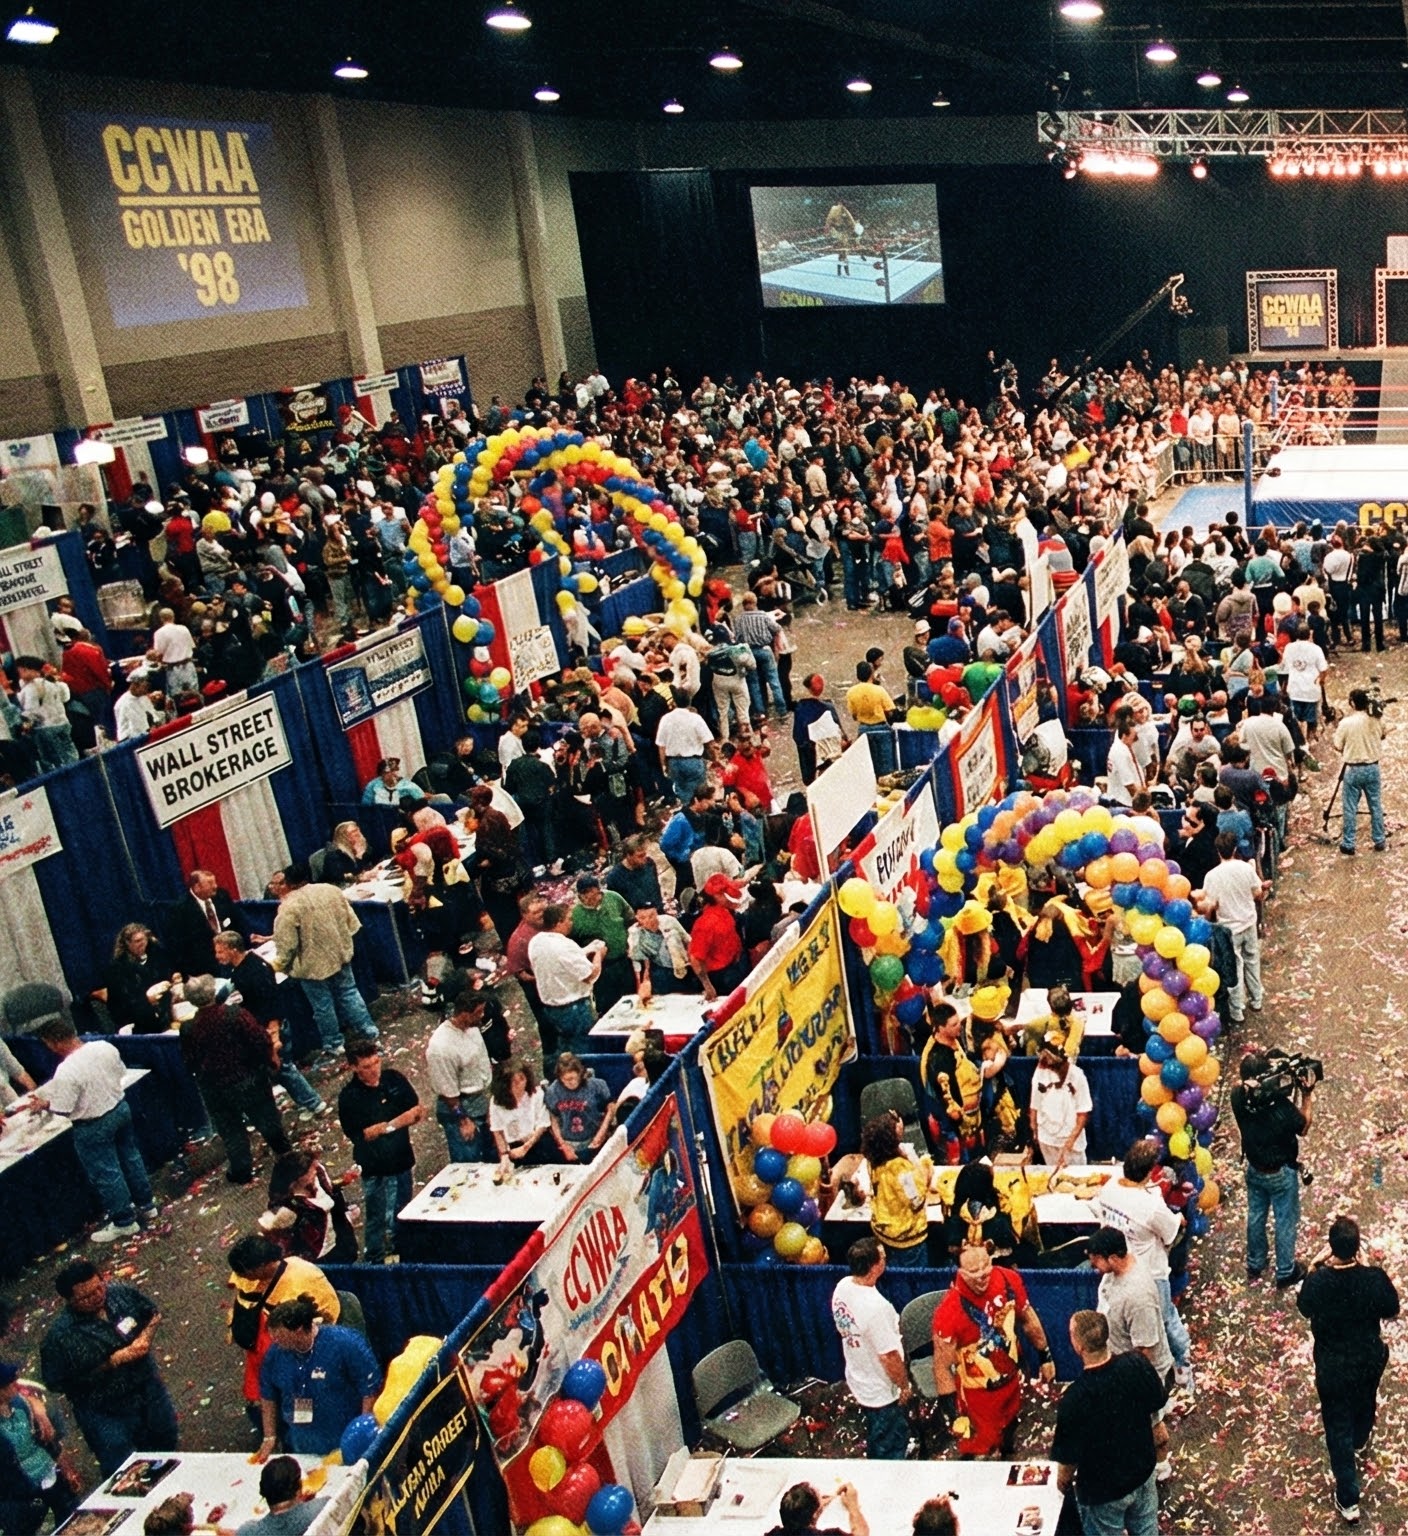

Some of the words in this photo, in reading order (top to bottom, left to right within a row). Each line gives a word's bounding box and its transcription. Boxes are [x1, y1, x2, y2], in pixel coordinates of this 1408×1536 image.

[102, 125, 260, 194] CCWAA
[122, 208, 222, 249] GOLDEN
[226, 207, 271, 244] ERA
[178, 251, 240, 307] '98
[1262, 293, 1323, 314] CCWAA
[146, 743, 203, 781] WALL
[207, 708, 273, 755] STREET
[162, 737, 278, 806] BROKERAGE
[563, 1205, 628, 1312] CCWAA
